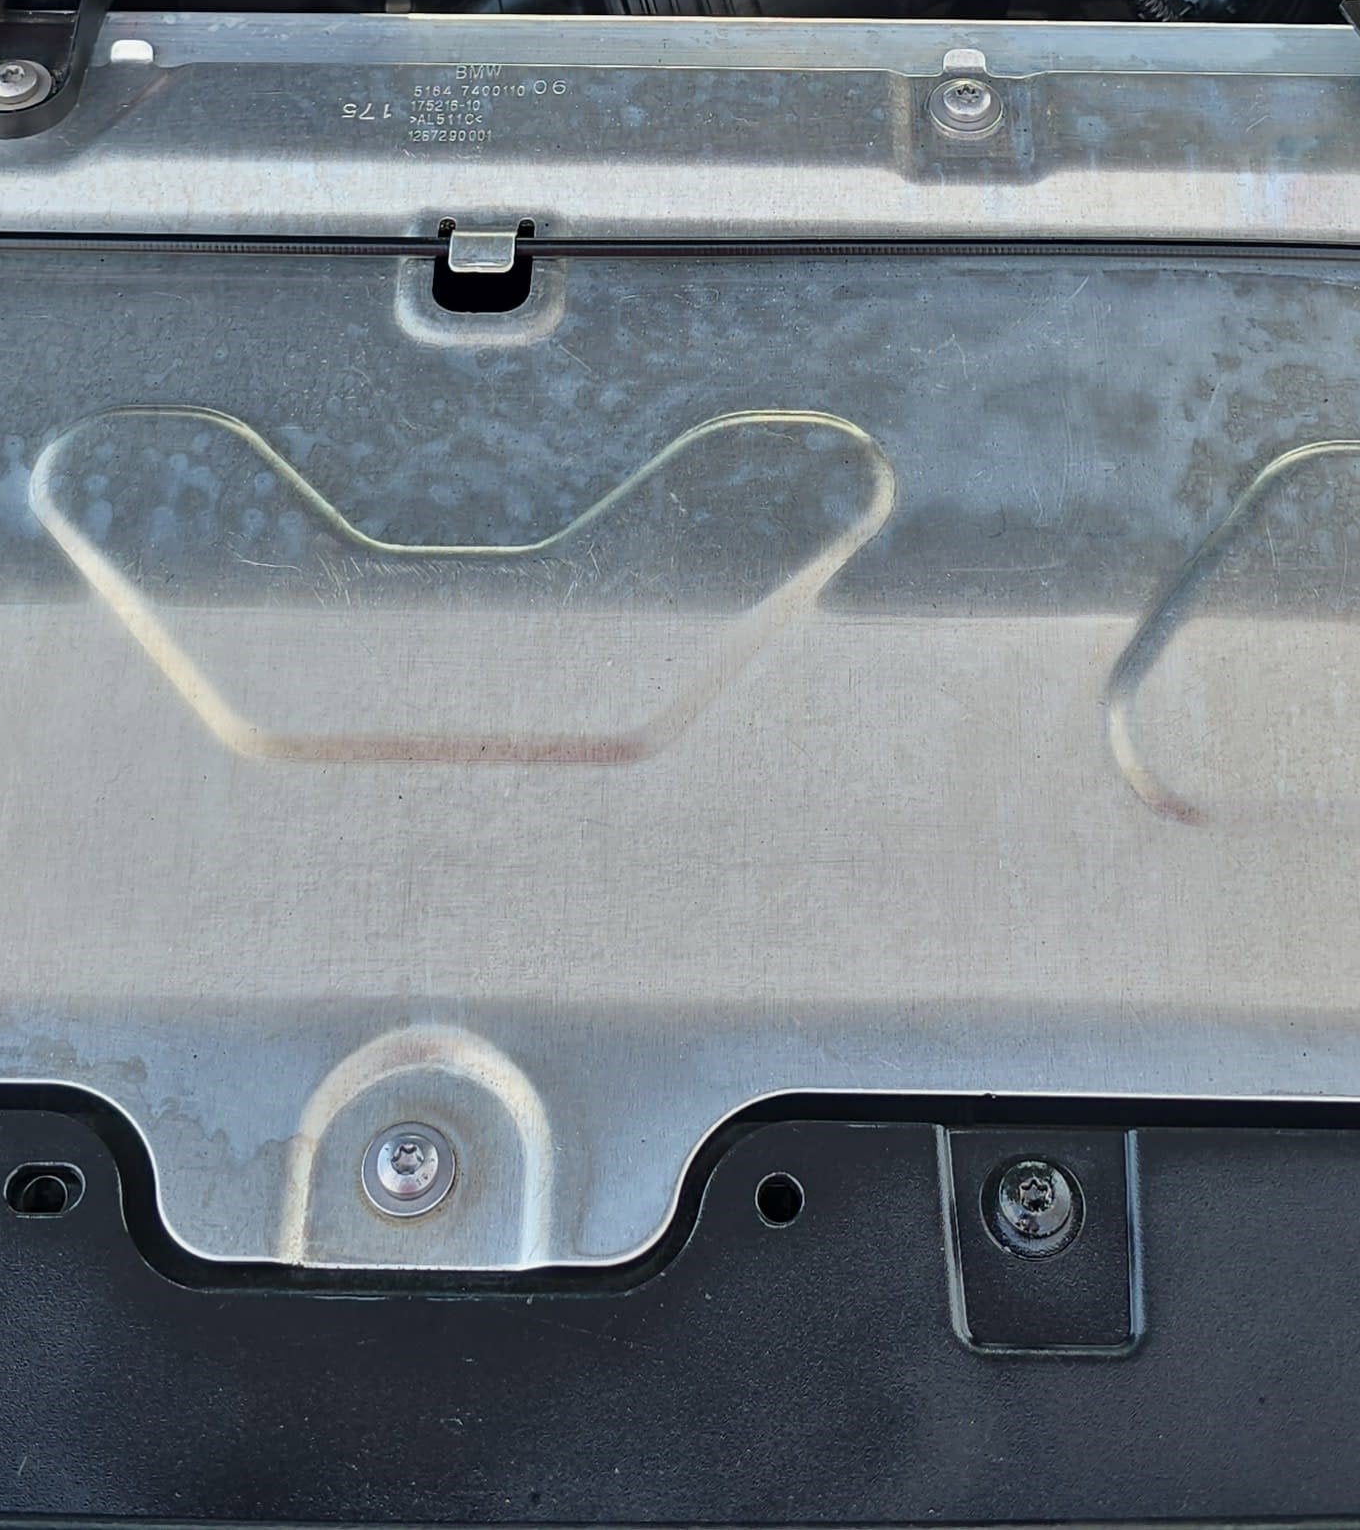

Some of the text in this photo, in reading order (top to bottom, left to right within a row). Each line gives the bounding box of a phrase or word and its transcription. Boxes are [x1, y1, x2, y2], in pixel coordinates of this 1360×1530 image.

[455, 64, 501, 80] BMW
[461, 85, 526, 97] 7400110
[533, 79, 568, 95] 06
